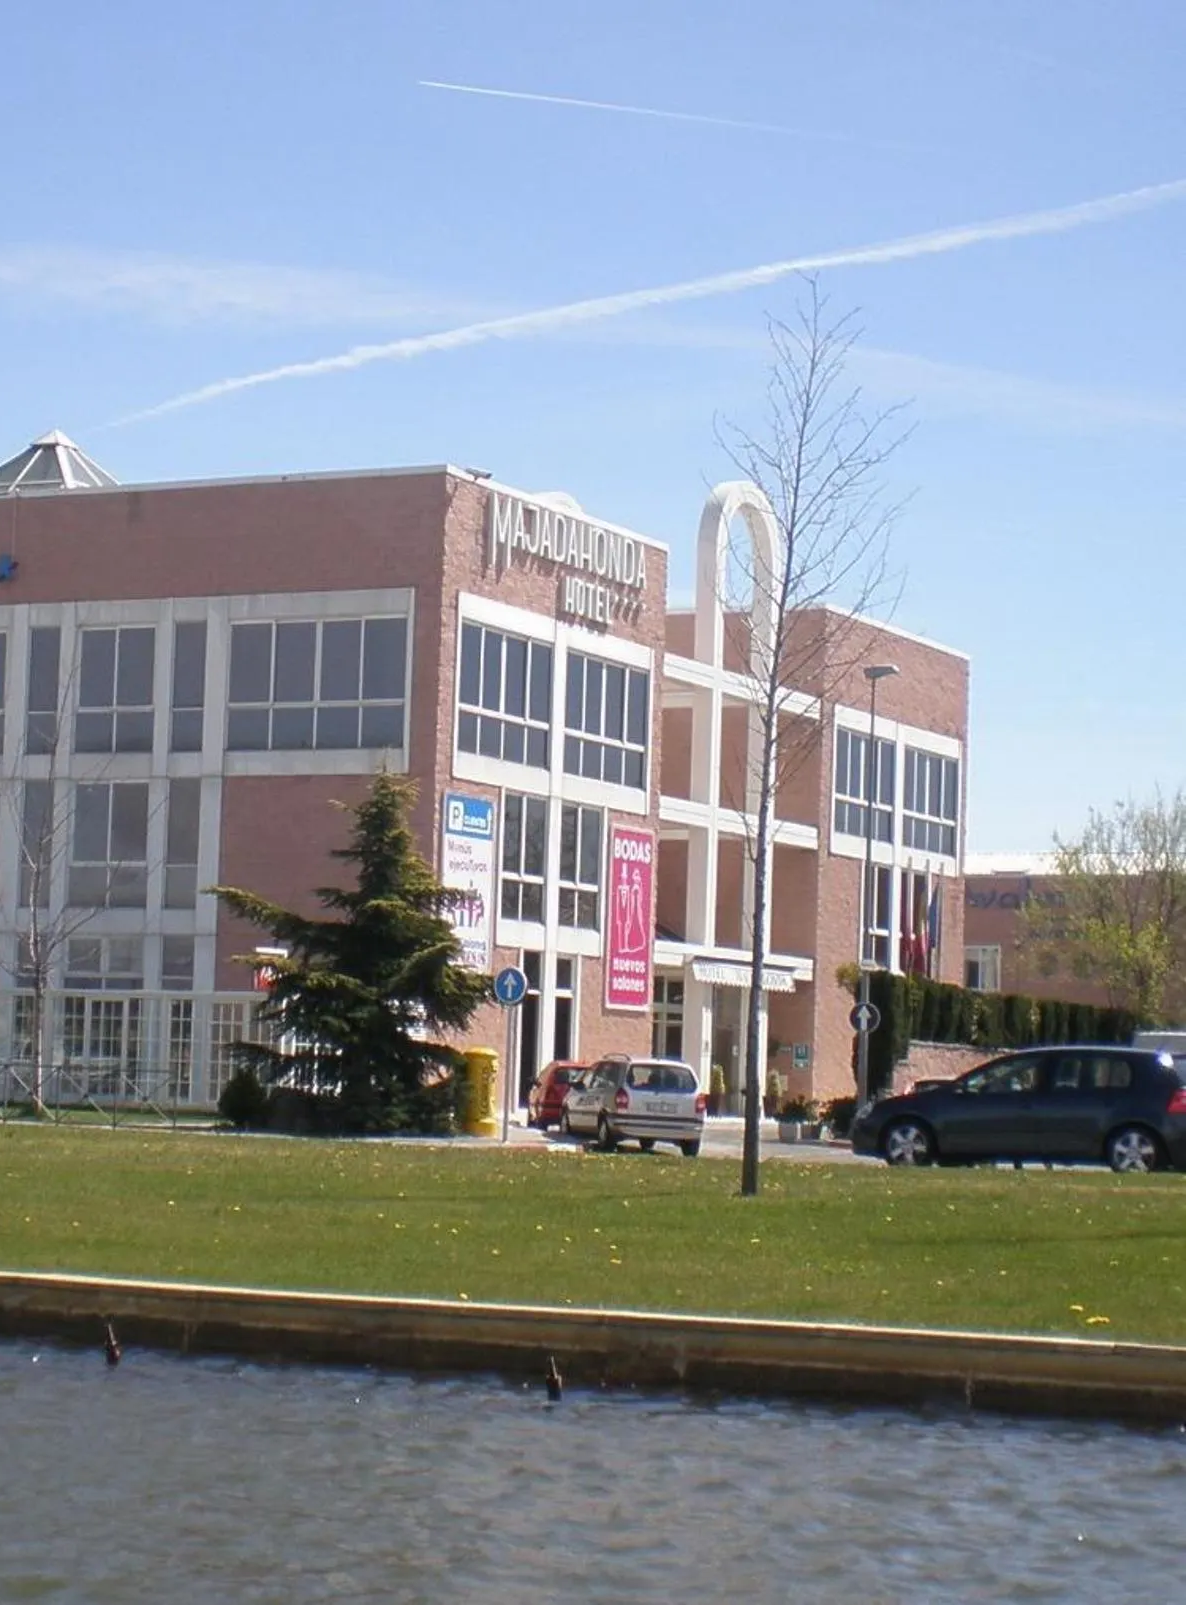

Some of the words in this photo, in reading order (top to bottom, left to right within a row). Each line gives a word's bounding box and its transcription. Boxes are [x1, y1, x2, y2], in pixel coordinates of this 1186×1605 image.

[490, 491, 647, 589] MAJADAHONDA
[563, 575, 613, 625] HOTEL
[614, 837, 651, 865] BODAS
[613, 957, 646, 973] nuevos
[613, 975, 645, 993] salones
